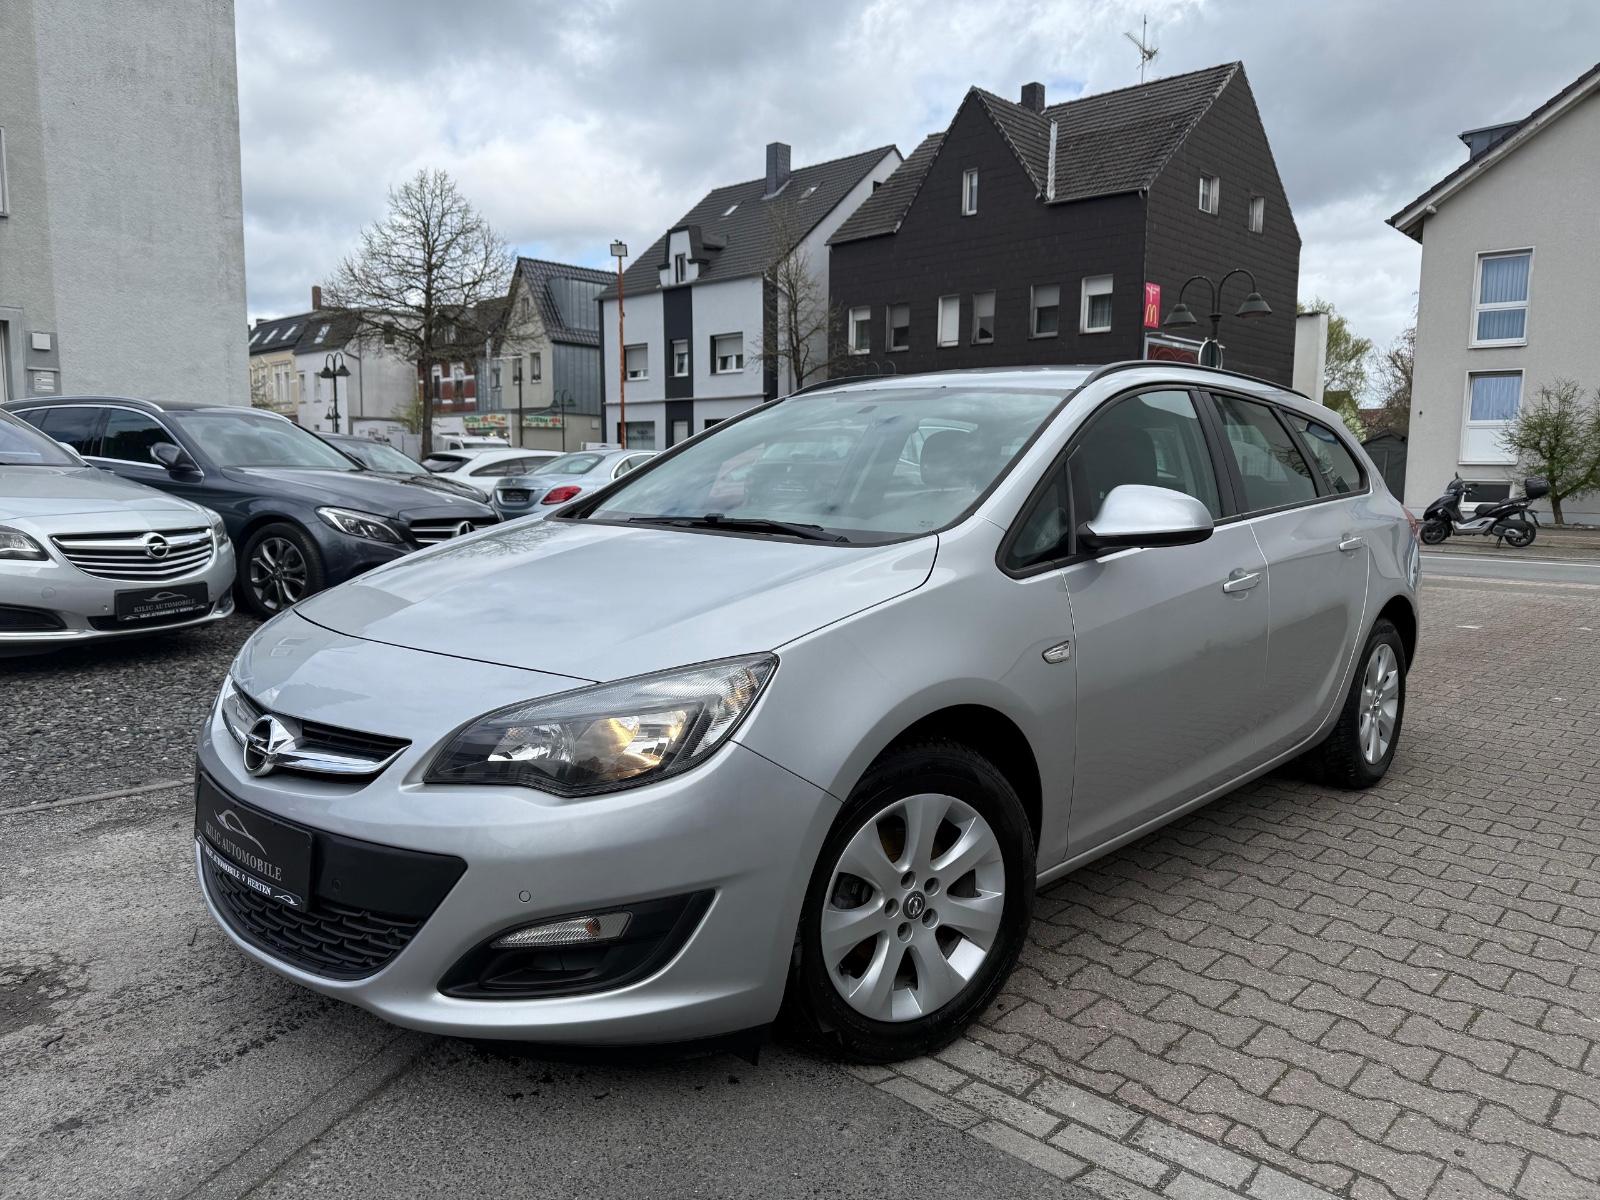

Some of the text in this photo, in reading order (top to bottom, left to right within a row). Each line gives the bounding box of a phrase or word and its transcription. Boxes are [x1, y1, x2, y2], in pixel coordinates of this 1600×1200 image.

[205, 820, 282, 882] KILIC AUTOMOBILE
[247, 876, 272, 896] HERTEN
